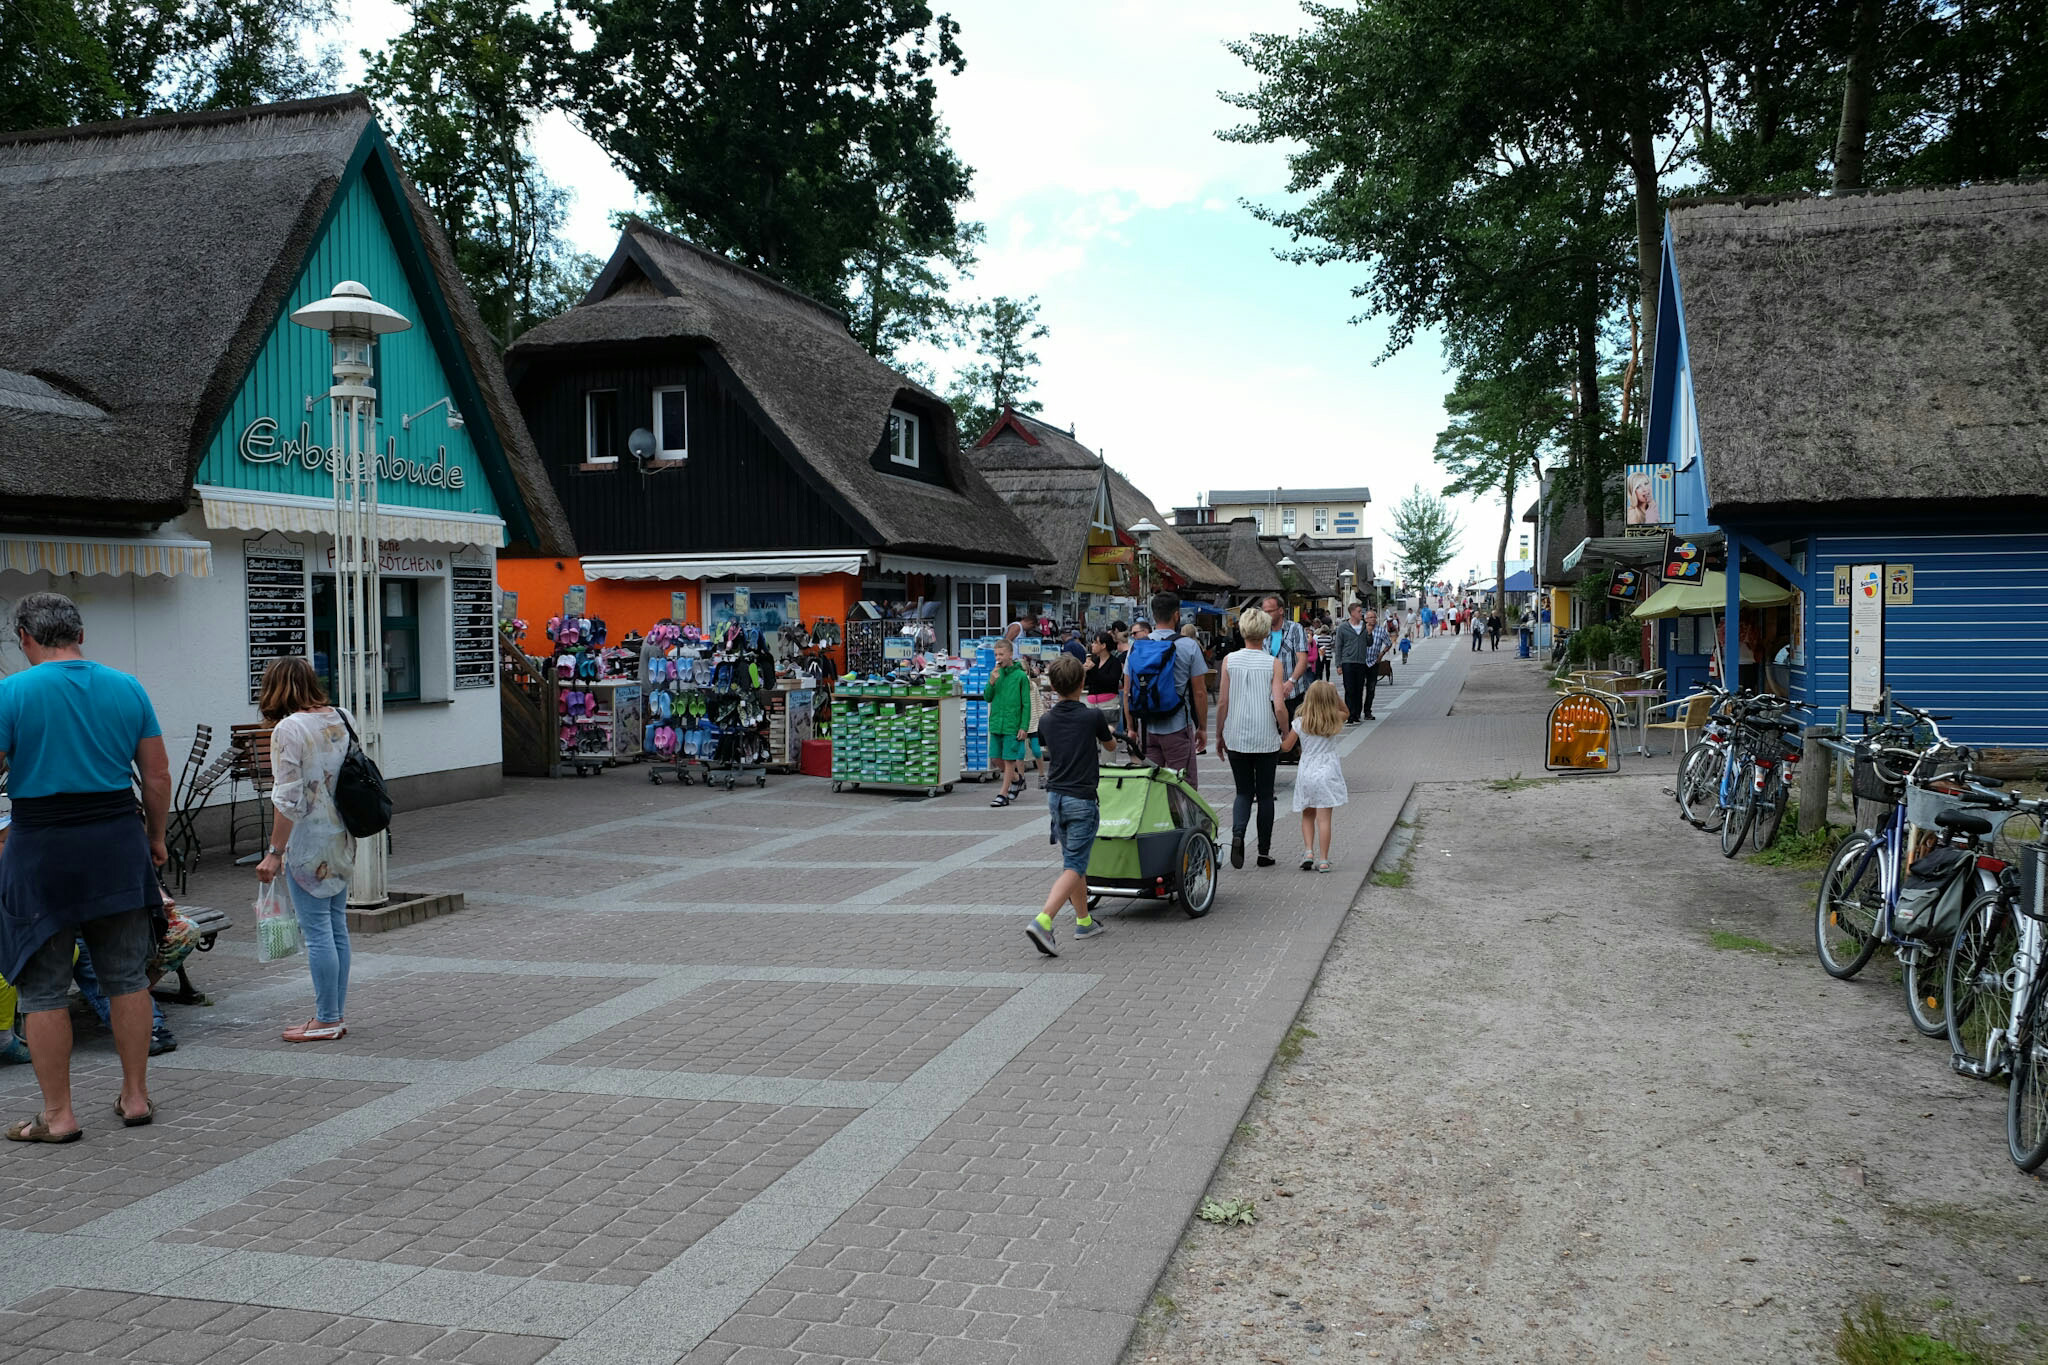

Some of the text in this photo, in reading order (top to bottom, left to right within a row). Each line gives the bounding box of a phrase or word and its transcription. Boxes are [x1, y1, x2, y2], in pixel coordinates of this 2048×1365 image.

[239, 416, 465, 489] Erbsenbude
[1667, 562, 1701, 577] EIS
[1611, 584, 1636, 596] EIS
[1892, 582, 1908, 595] EIS
[1554, 722, 1576, 743] EIS
